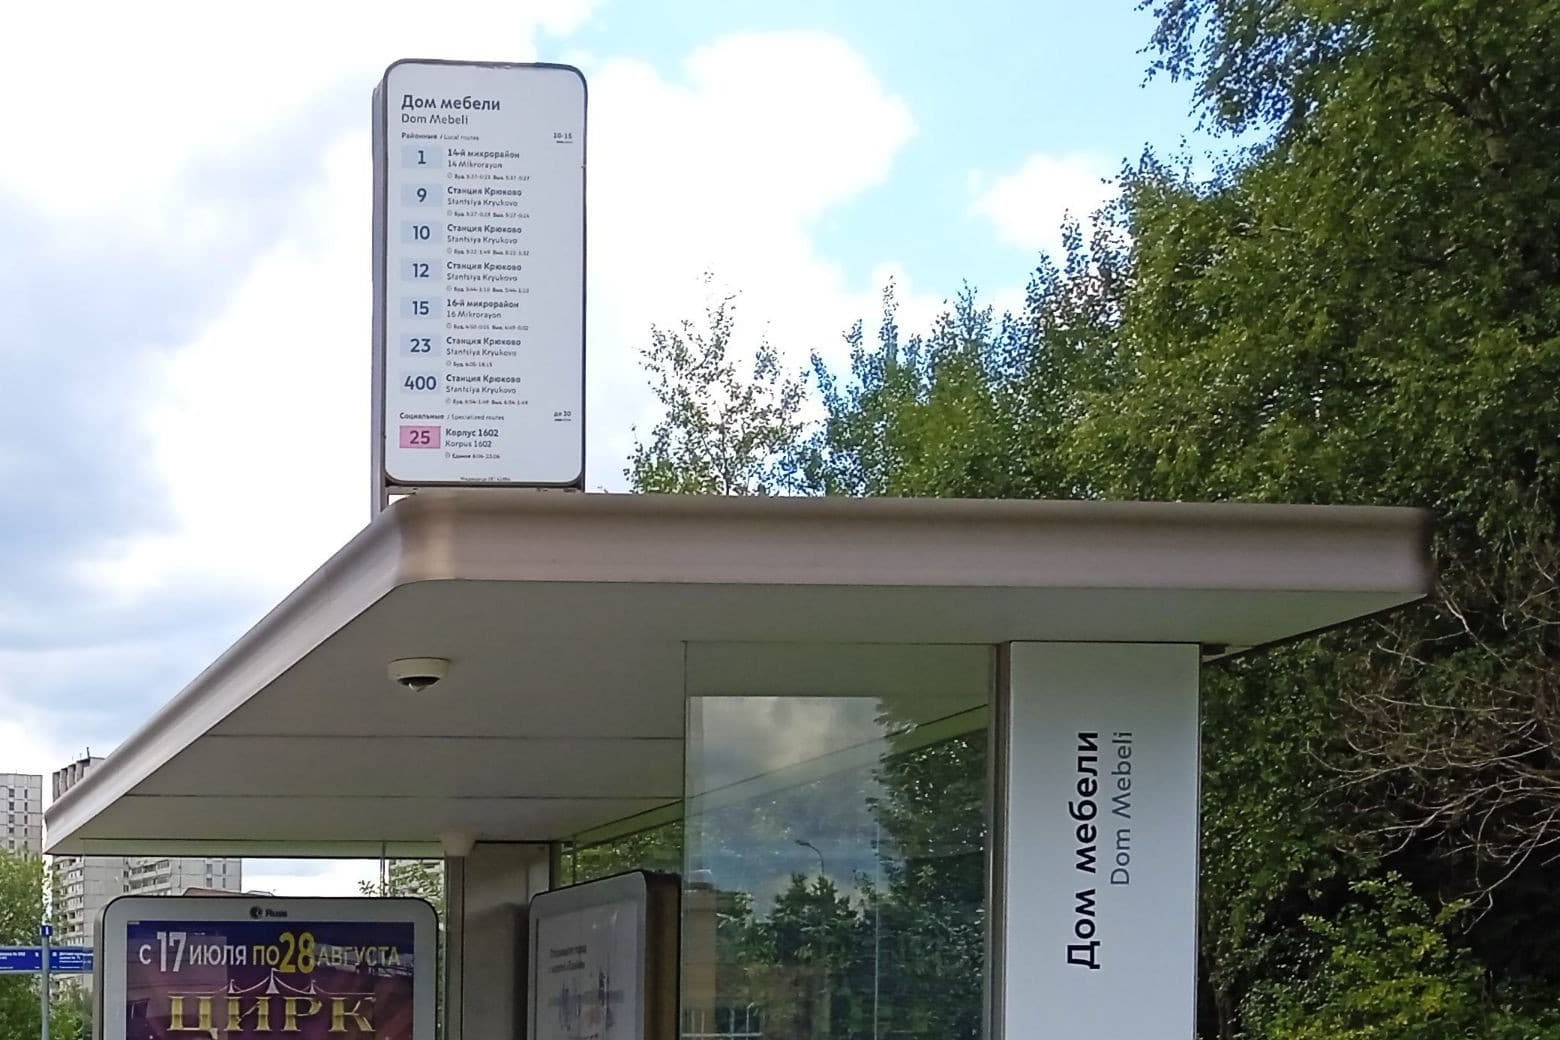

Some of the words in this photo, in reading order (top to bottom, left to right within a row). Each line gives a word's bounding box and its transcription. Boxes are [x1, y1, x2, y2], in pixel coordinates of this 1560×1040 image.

[401, 95, 436, 110] Дом
[440, 96, 500, 110] мебели
[401, 114, 426, 124] Dom
[429, 114, 468, 125] Mebeli
[417, 150, 427, 165] 1
[467, 150, 520, 160] микрорайон
[447, 160, 457, 168] 14
[458, 161, 503, 169] Mikrorayon
[416, 187, 427, 202] 9
[447, 186, 482, 196] Станция
[484, 187, 522, 196] Крюково
[412, 226, 430, 240] 10
[447, 224, 482, 234] Станция
[484, 225, 522, 234] Крюково
[412, 263, 429, 278] 12
[447, 261, 482, 271] Станция
[484, 262, 522, 271] Крюково
[412, 301, 429, 315] 15
[466, 300, 519, 309] микрорайон
[457, 311, 502, 319] Mikrorayon
[410, 338, 431, 353] 23
[446, 336, 481, 346] Станция
[483, 337, 521, 346] Крюково
[404, 376, 437, 390] 400
[446, 374, 481, 384] Станция
[483, 375, 521, 384] Крюково
[409, 430, 430, 445] 25
[445, 429, 476, 438] Корпус
[478, 429, 499, 437] 1602
[445, 440, 472, 449] Korpus
[474, 440, 492, 448] 1602
[1111, 731, 1132, 819] Mebeli
[1068, 732, 1098, 874] мебели
[1110, 828, 1130, 885] Dom
[1067, 888, 1101, 970] Дом
[156, 931, 187, 972] 17
[190, 944, 246, 966] ИЮЛЯ
[253, 945, 280, 966] ПО
[279, 932, 316, 974] 28
[317, 946, 401, 967] АВГУСТА
[167, 996, 376, 1040] ЦИРК
